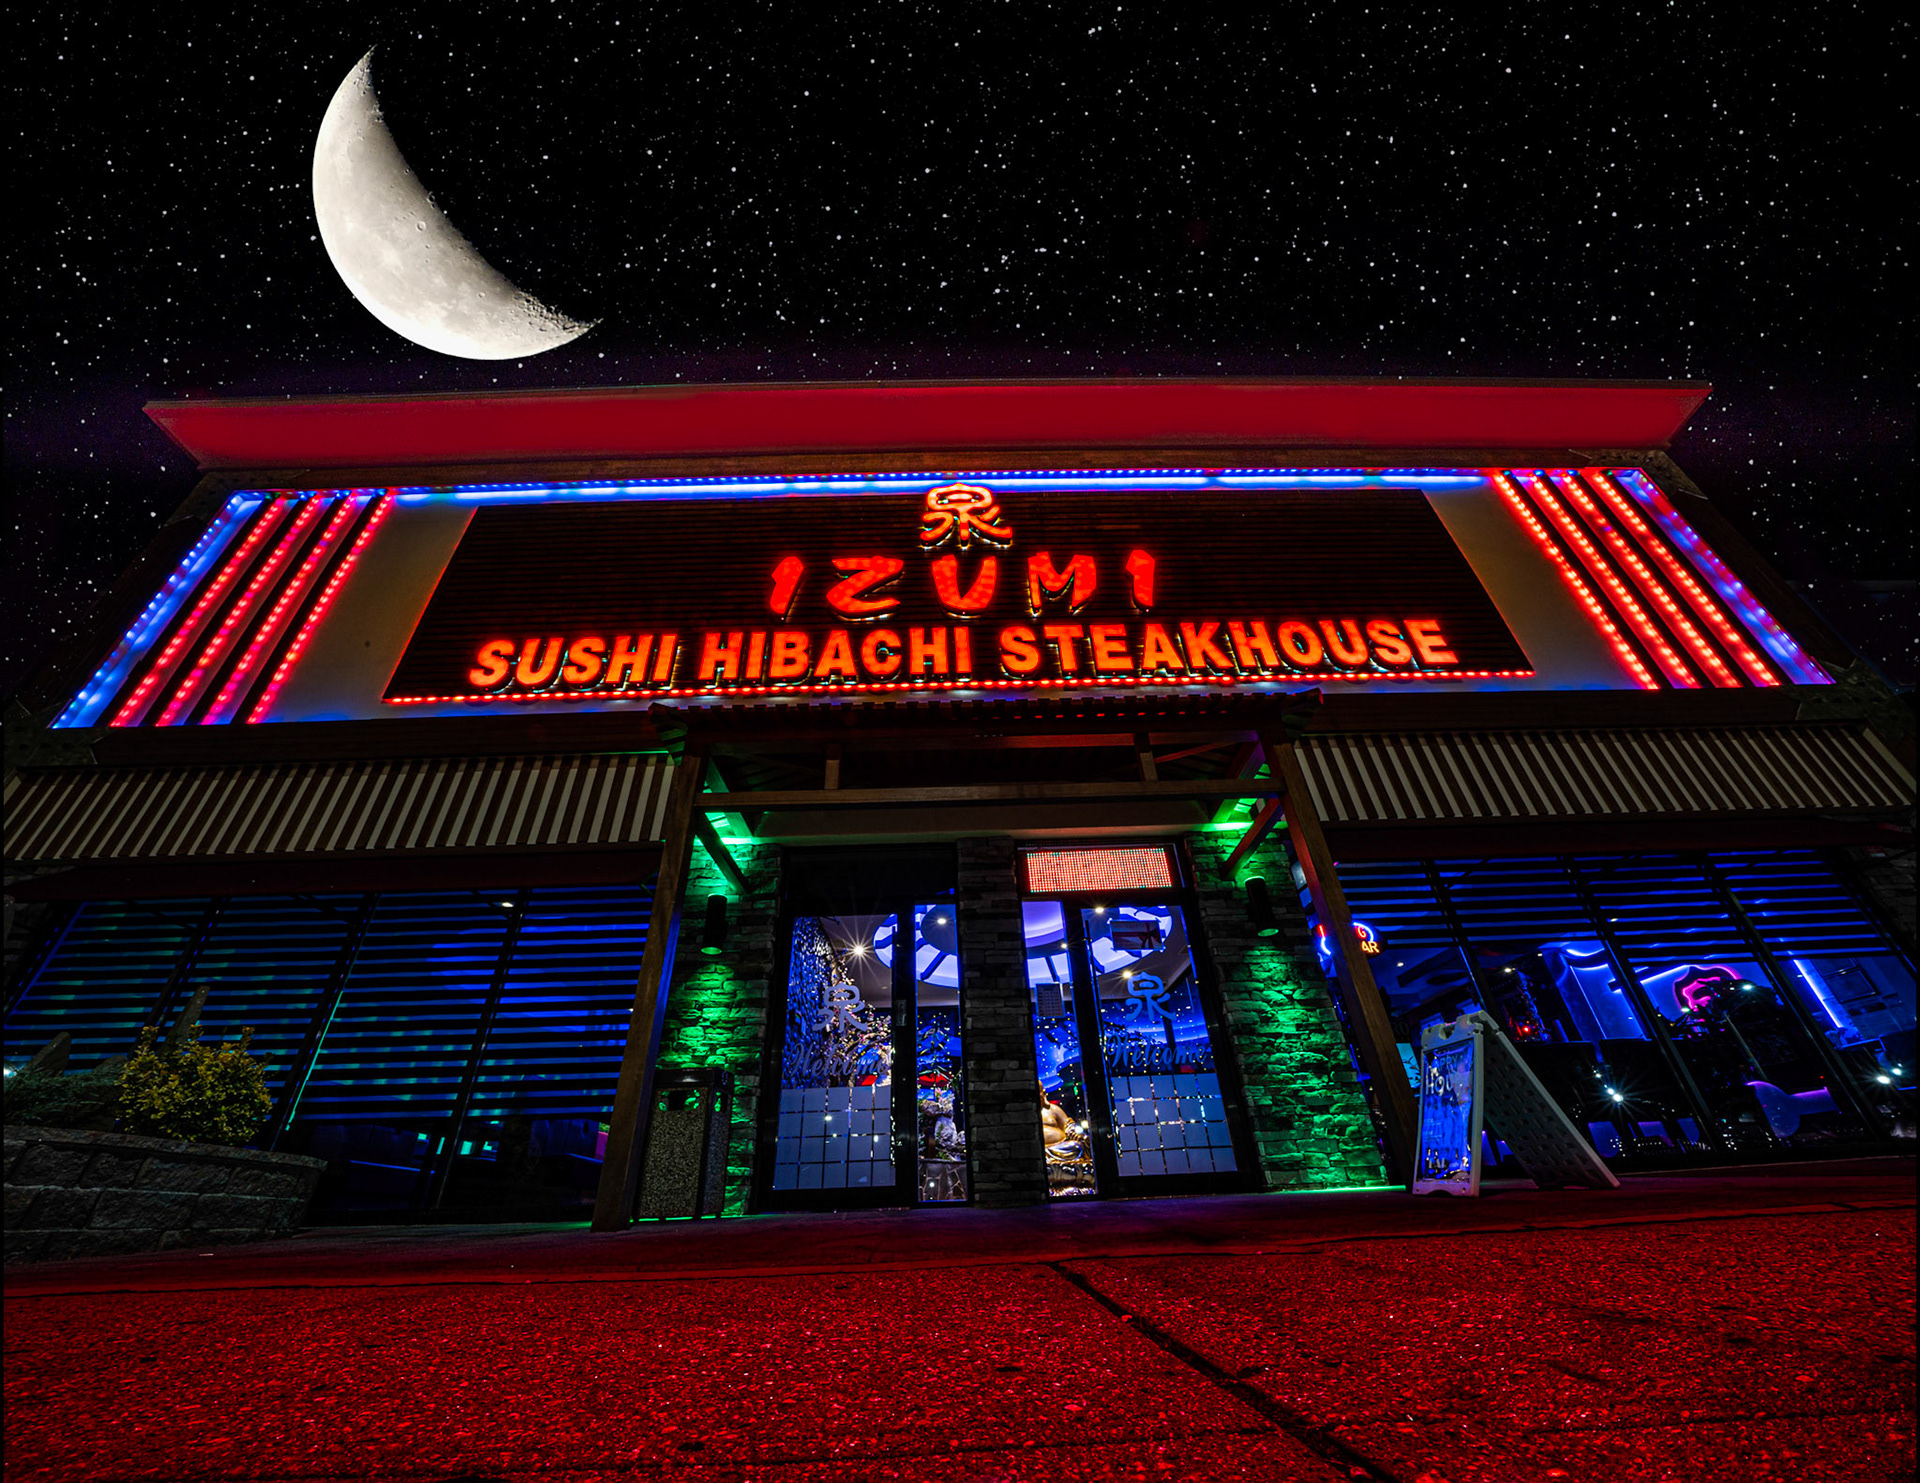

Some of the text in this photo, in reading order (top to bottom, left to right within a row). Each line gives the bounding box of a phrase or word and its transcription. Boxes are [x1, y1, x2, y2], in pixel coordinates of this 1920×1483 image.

[769, 549, 1156, 614] IZUMI
[469, 619, 1459, 686] SUSHI HIBACHI STEAKHOUSE
[789, 1042, 889, 1077] Welcome
[1107, 1034, 1211, 1067] Welcome
